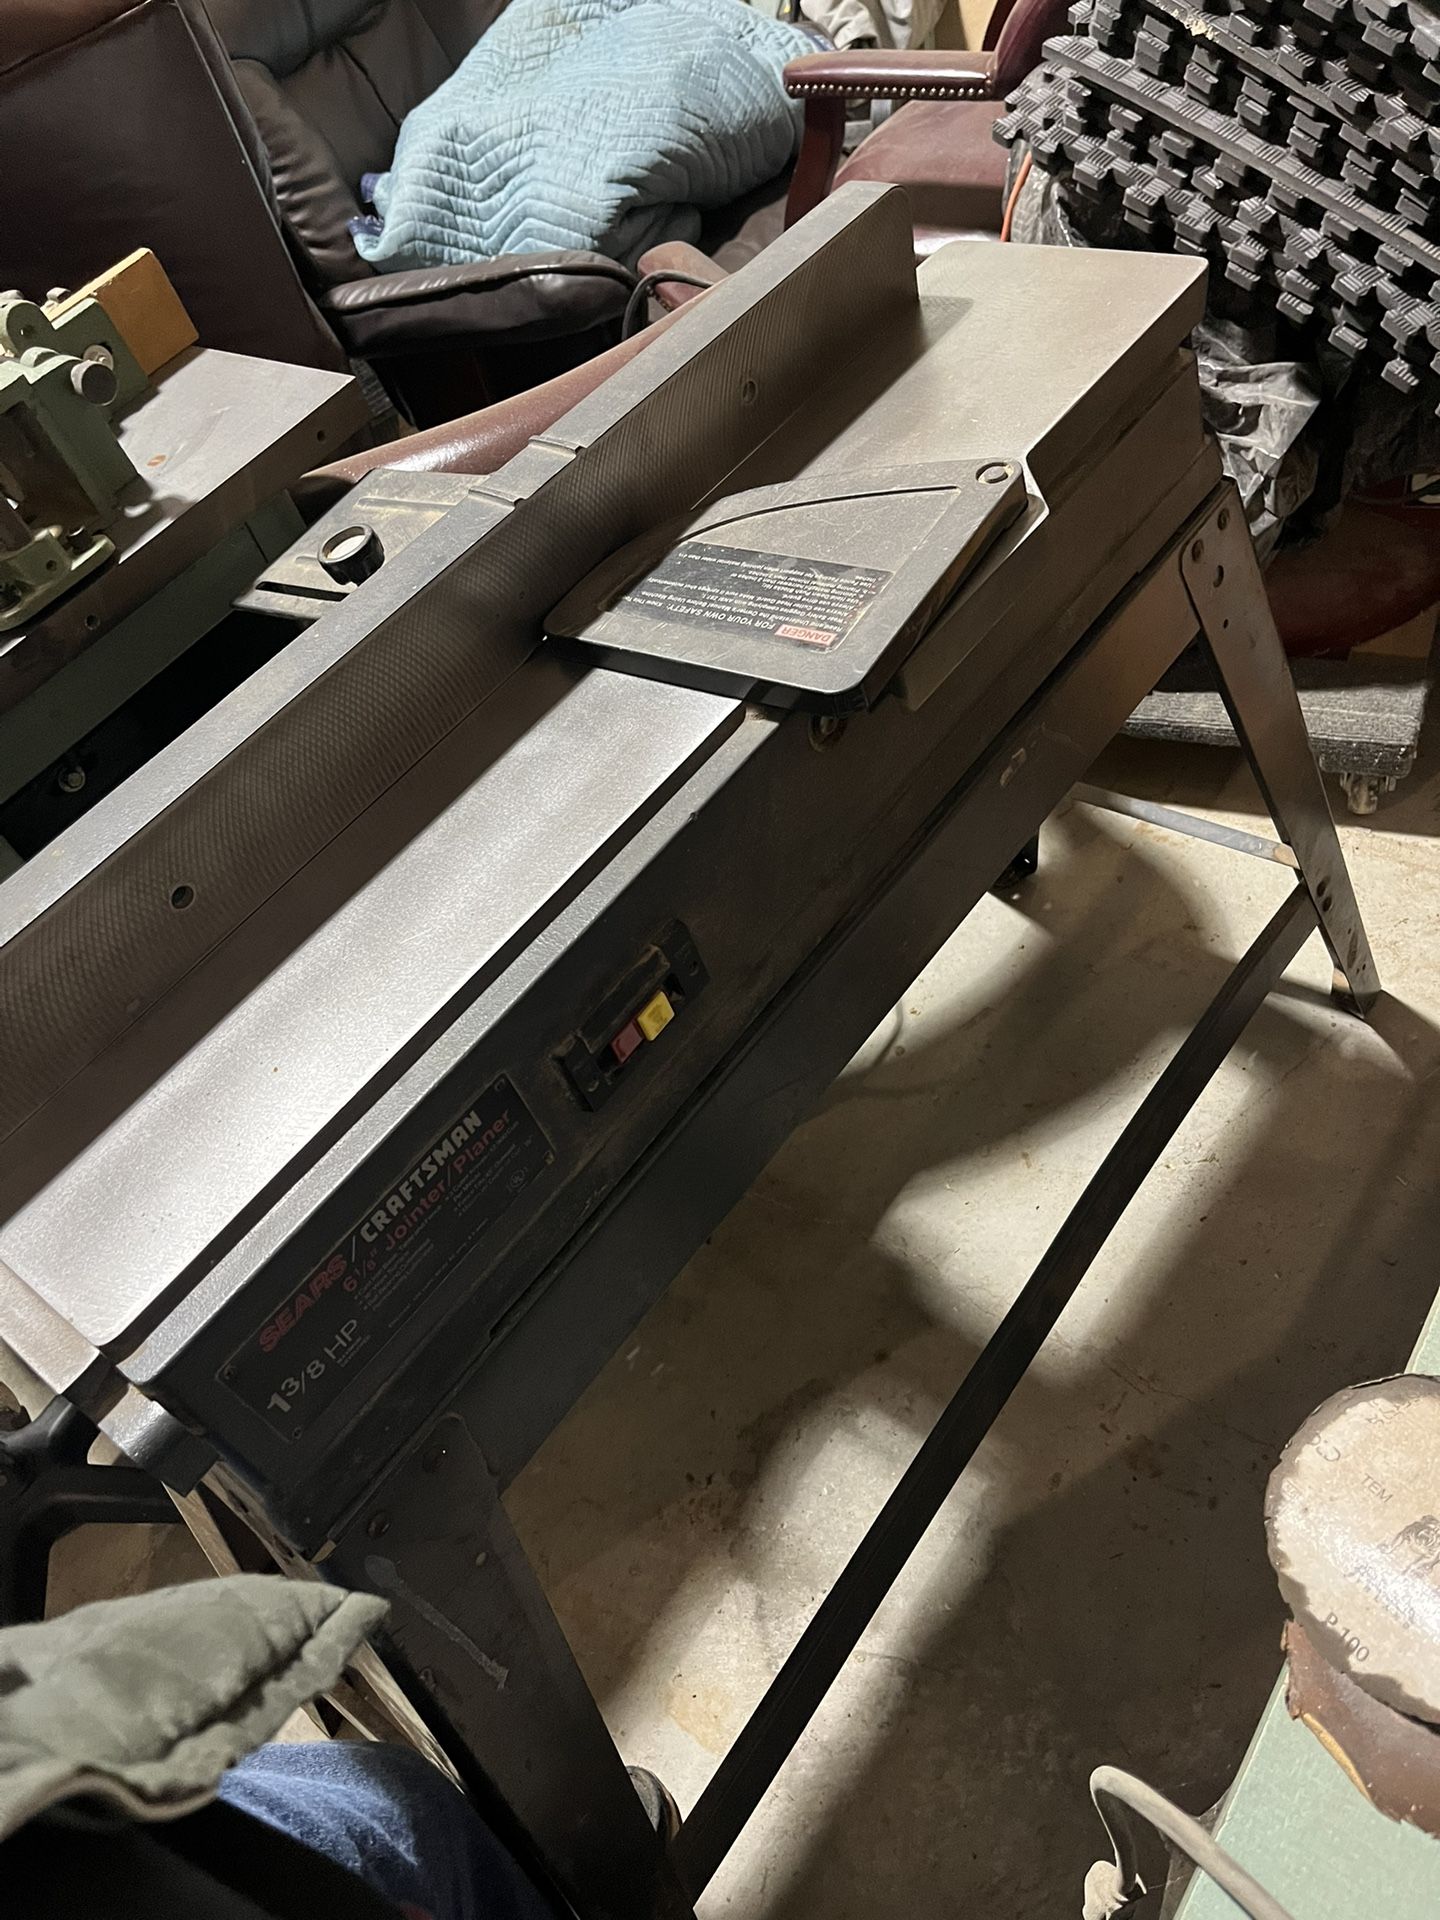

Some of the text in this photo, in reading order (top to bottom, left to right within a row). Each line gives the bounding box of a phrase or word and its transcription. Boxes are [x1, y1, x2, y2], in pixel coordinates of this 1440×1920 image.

[685, 598, 707, 606] Before
[706, 602, 731, 611] Manual
[830, 601, 854, 609] Always
[665, 603, 776, 629] FOR YOUR OWN SAFETY:
[731, 607, 758, 616] Owner's
[779, 607, 806, 616] Goggles
[805, 611, 827, 619] Safety
[770, 614, 808, 625] Understand
[823, 623, 842, 631] Read
[780, 626, 831, 642] DANGER
[324, 1319, 358, 1360] HP
[1361, 1473, 1394, 1503] TEM
[1340, 1627, 1370, 1662] 100
